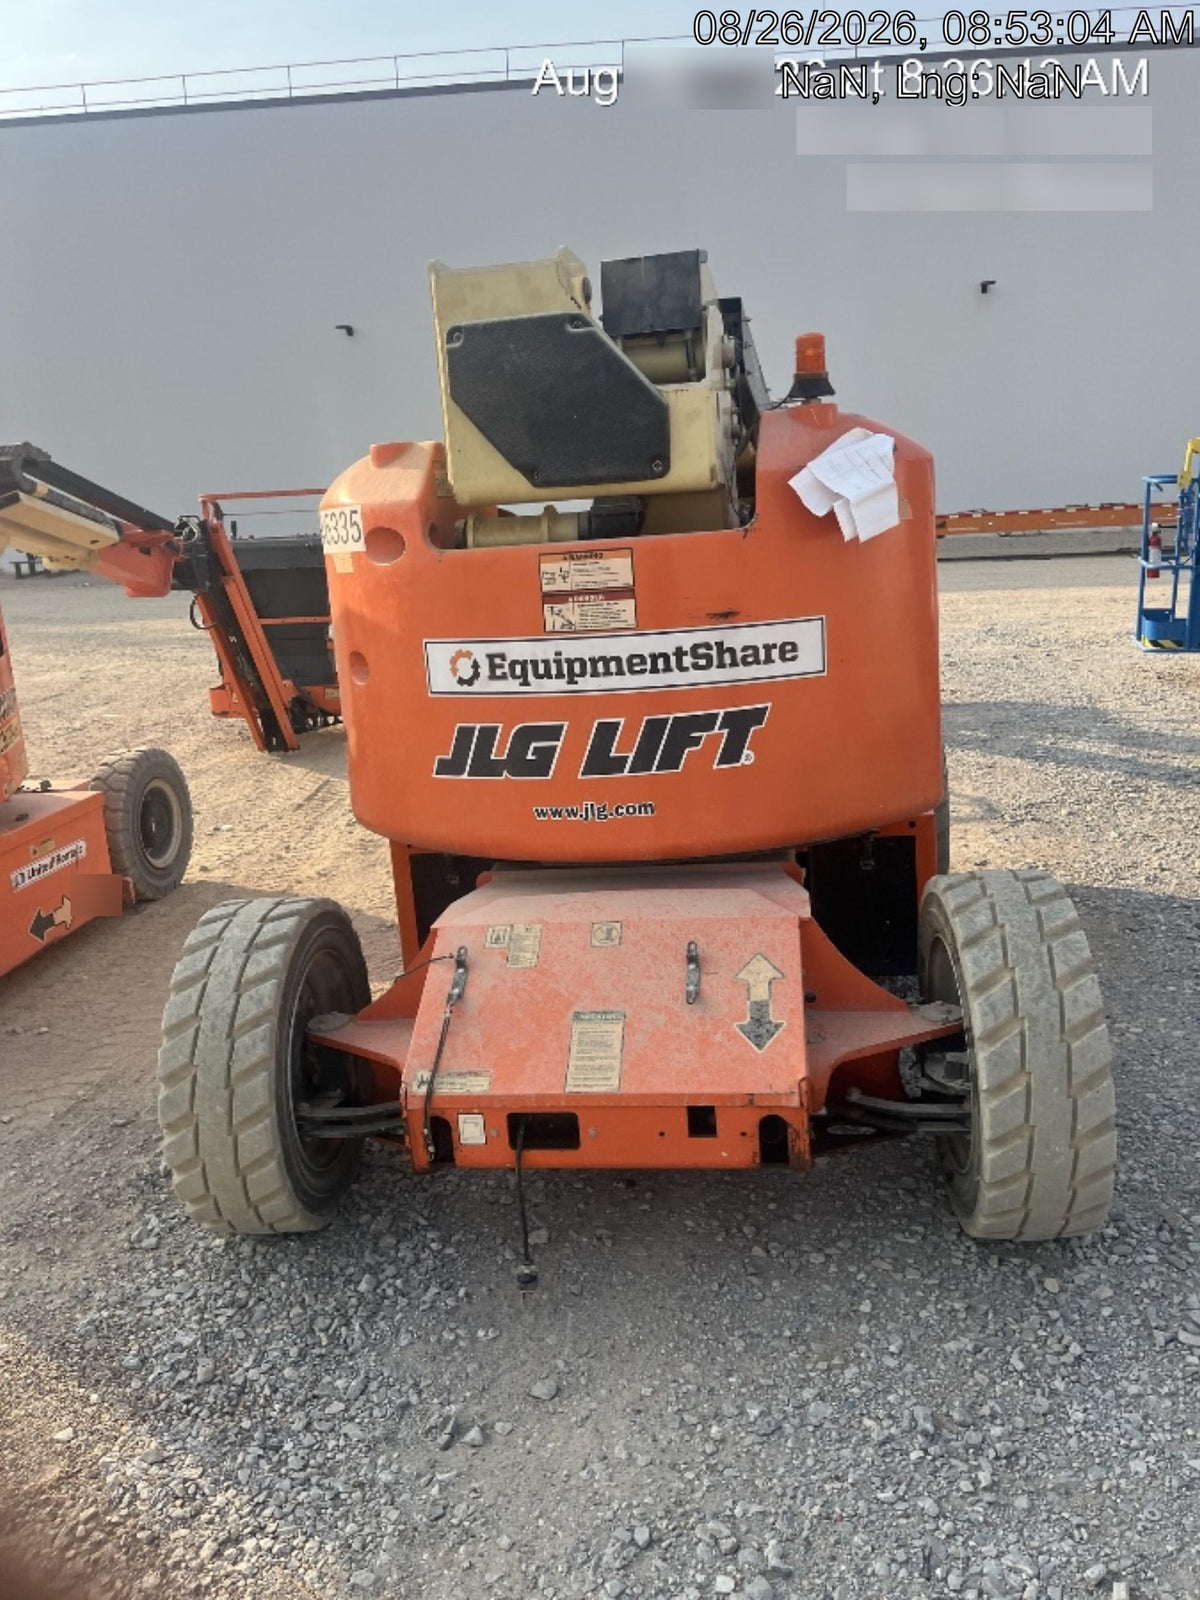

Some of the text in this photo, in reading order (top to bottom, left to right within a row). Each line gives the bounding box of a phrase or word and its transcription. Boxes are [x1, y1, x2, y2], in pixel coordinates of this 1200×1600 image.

[486, 639, 800, 687] EquipmentShare
[432, 702, 773, 780] JLG LIFT
[533, 801, 656, 822] www.jlg.com
